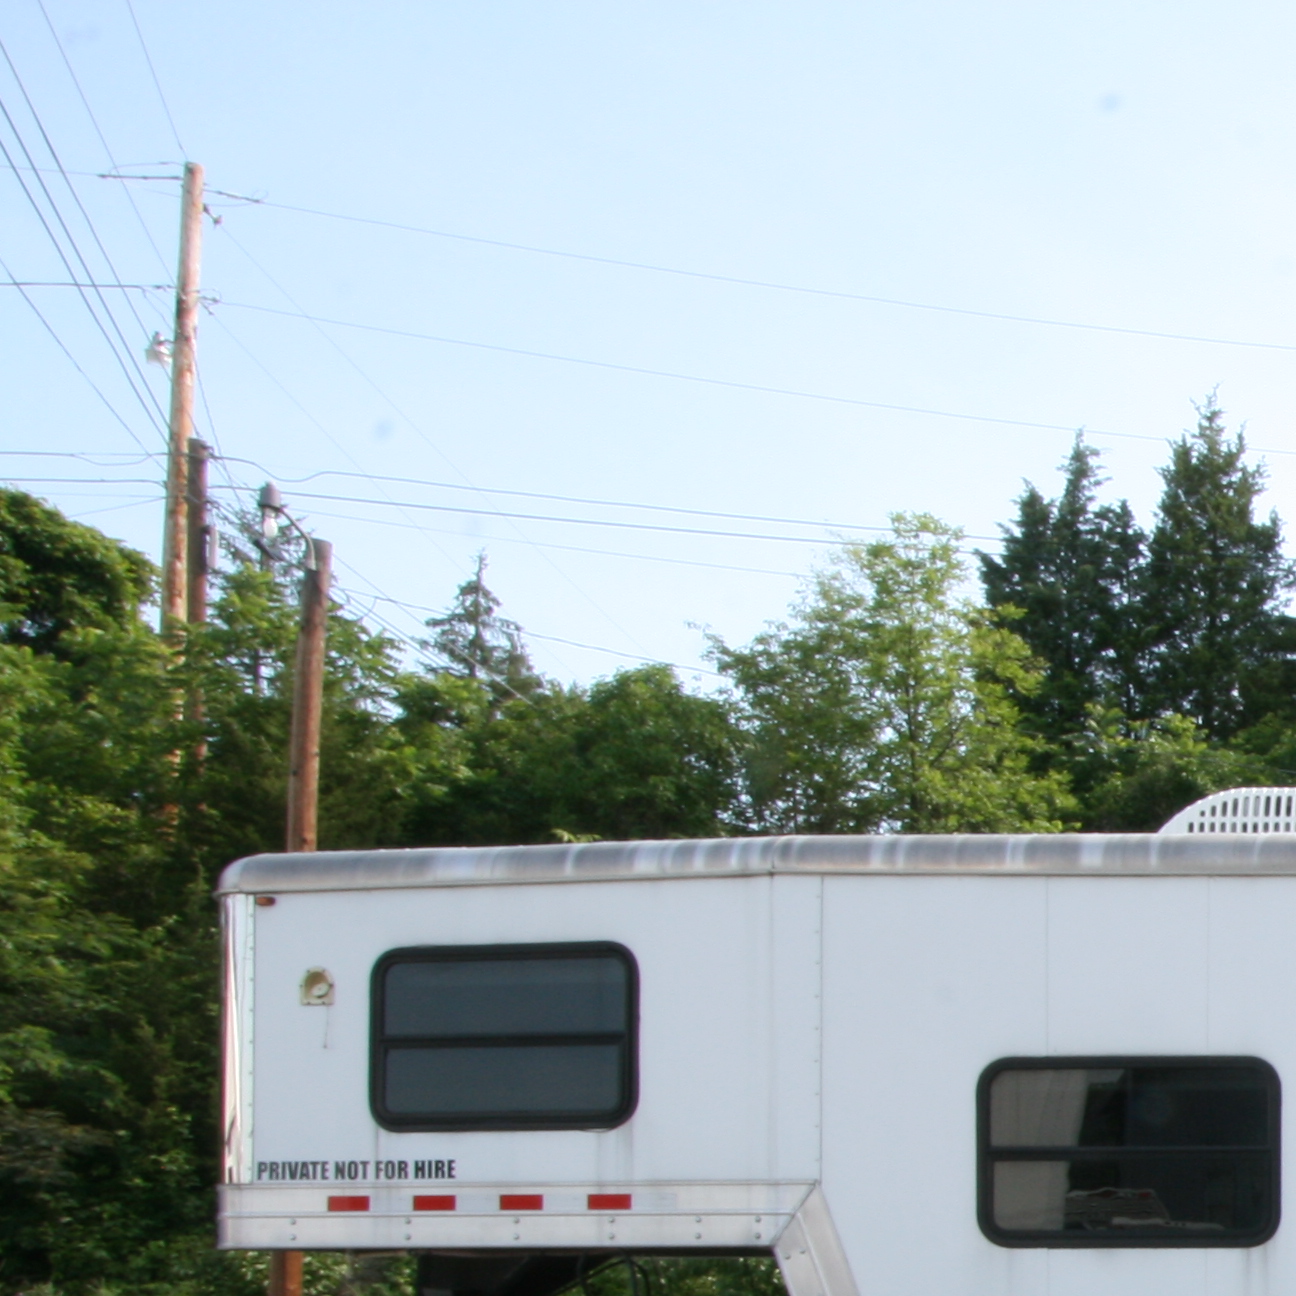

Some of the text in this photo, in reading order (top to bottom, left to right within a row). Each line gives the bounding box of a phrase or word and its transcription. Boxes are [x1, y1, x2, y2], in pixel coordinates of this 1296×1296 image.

[257, 1158, 456, 1181] PRIVATE NOT FOR HIRE
